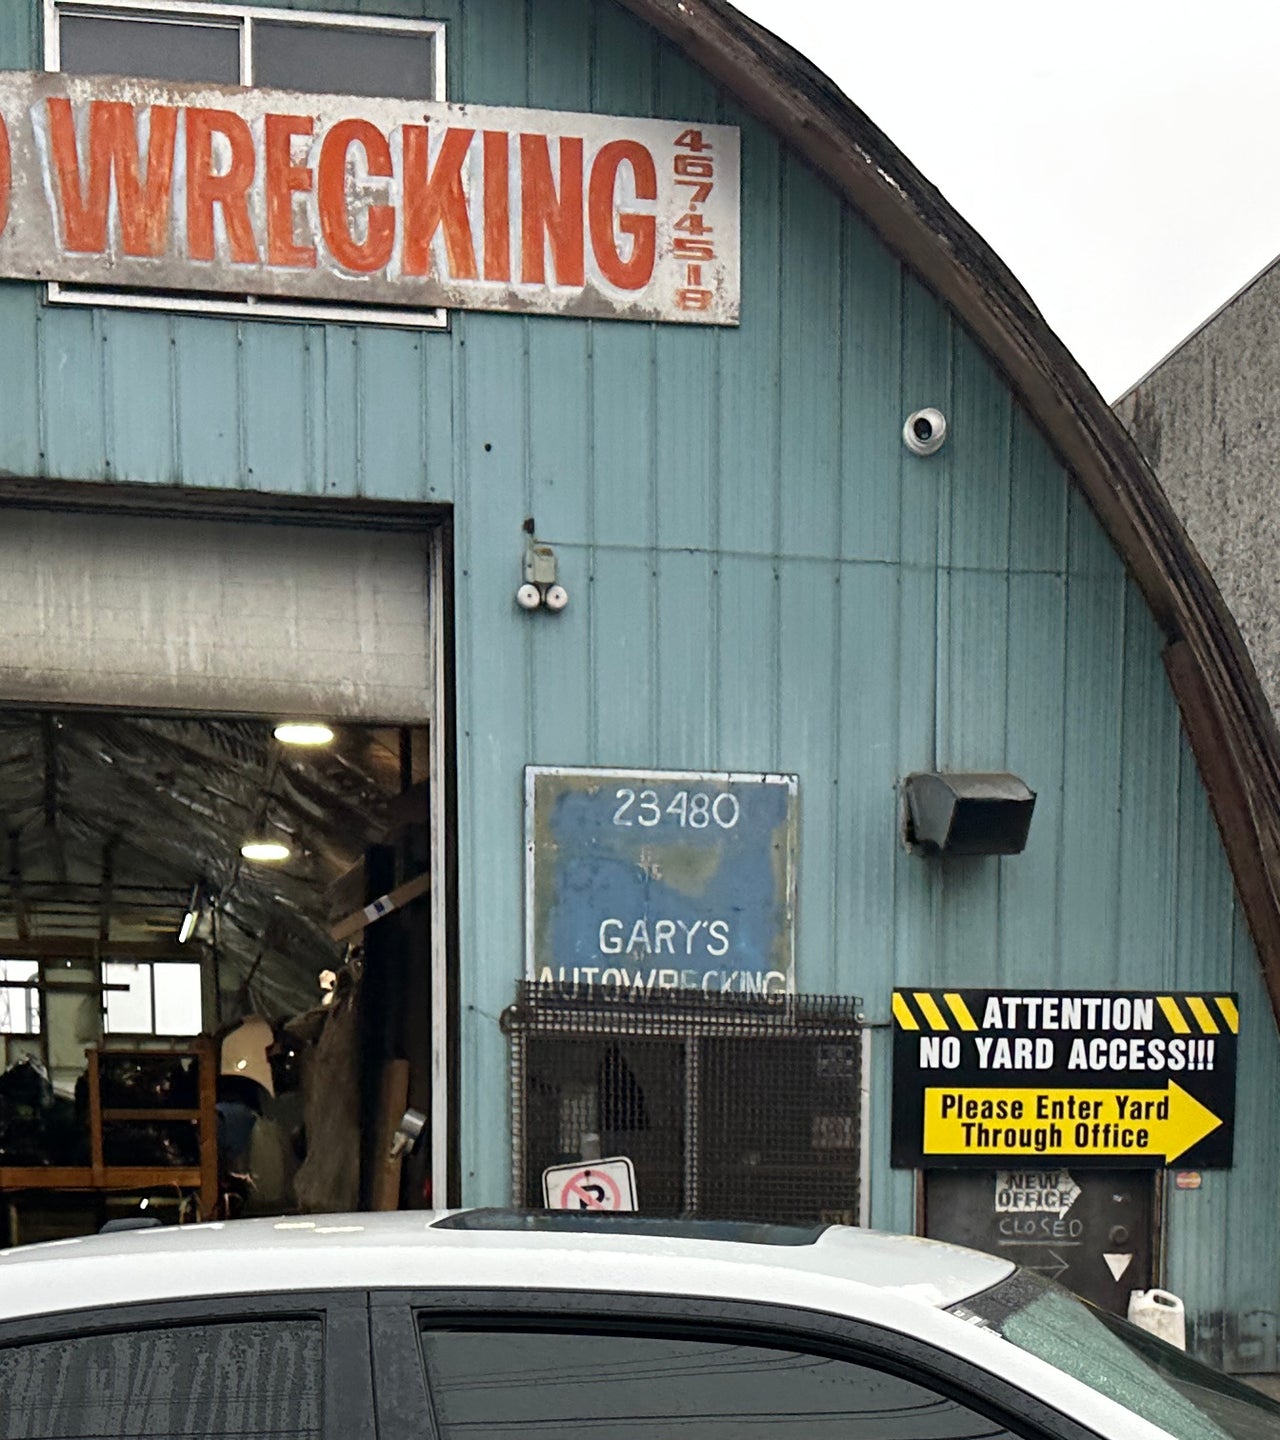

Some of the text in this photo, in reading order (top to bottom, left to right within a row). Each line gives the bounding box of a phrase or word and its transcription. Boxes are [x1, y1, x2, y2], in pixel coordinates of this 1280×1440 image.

[46, 97, 658, 291] WRECKING
[612, 788, 740, 829] 23480
[598, 918, 730, 957] GARY'S
[982, 996, 1153, 1031] ATTENTION
[920, 1036, 1215, 1071] NO YARD ACCESS!!!
[941, 1094, 1169, 1120] Please Enter Yard
[961, 1122, 1149, 1151] Through Office
[1007, 1171, 1059, 1190] NEW
[998, 1189, 1072, 1209] OFFICE
[1000, 1216, 1083, 1237] CLOSED
